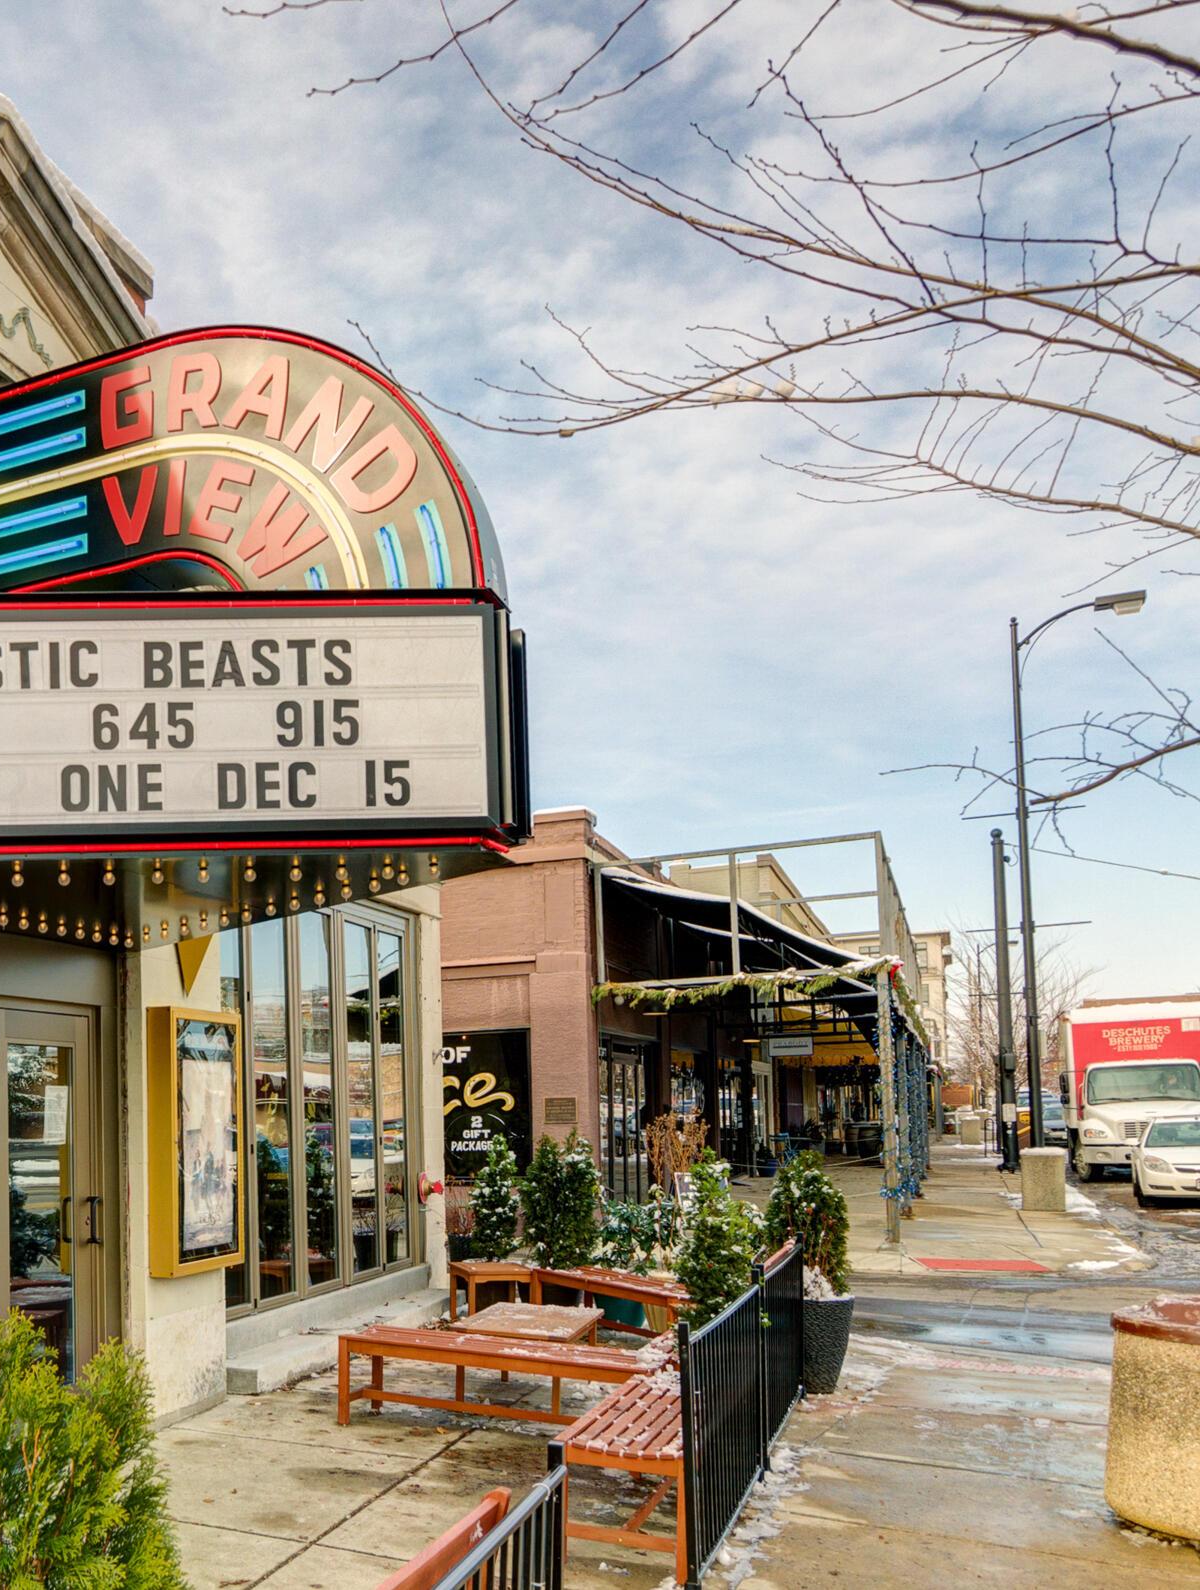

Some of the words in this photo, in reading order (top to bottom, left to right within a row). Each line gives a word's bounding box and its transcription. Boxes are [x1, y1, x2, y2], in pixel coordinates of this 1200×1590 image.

[100, 352, 417, 514] GRAND
[102, 459, 329, 579] VIEW
[144, 638, 352, 689] BEASTS
[92, 702, 194, 751] 645
[276, 699, 360, 747] 915
[60, 764, 163, 812] ONE
[217, 762, 317, 810] DEC
[365, 759, 411, 807] 15
[1102, 1026, 1171, 1038] DESCHUTES
[1108, 1034, 1165, 1046] BREWERY
[442, 1046, 471, 1064] OF
[462, 1129, 491, 1139] GIFT
[471, 1116, 483, 1129] 2
